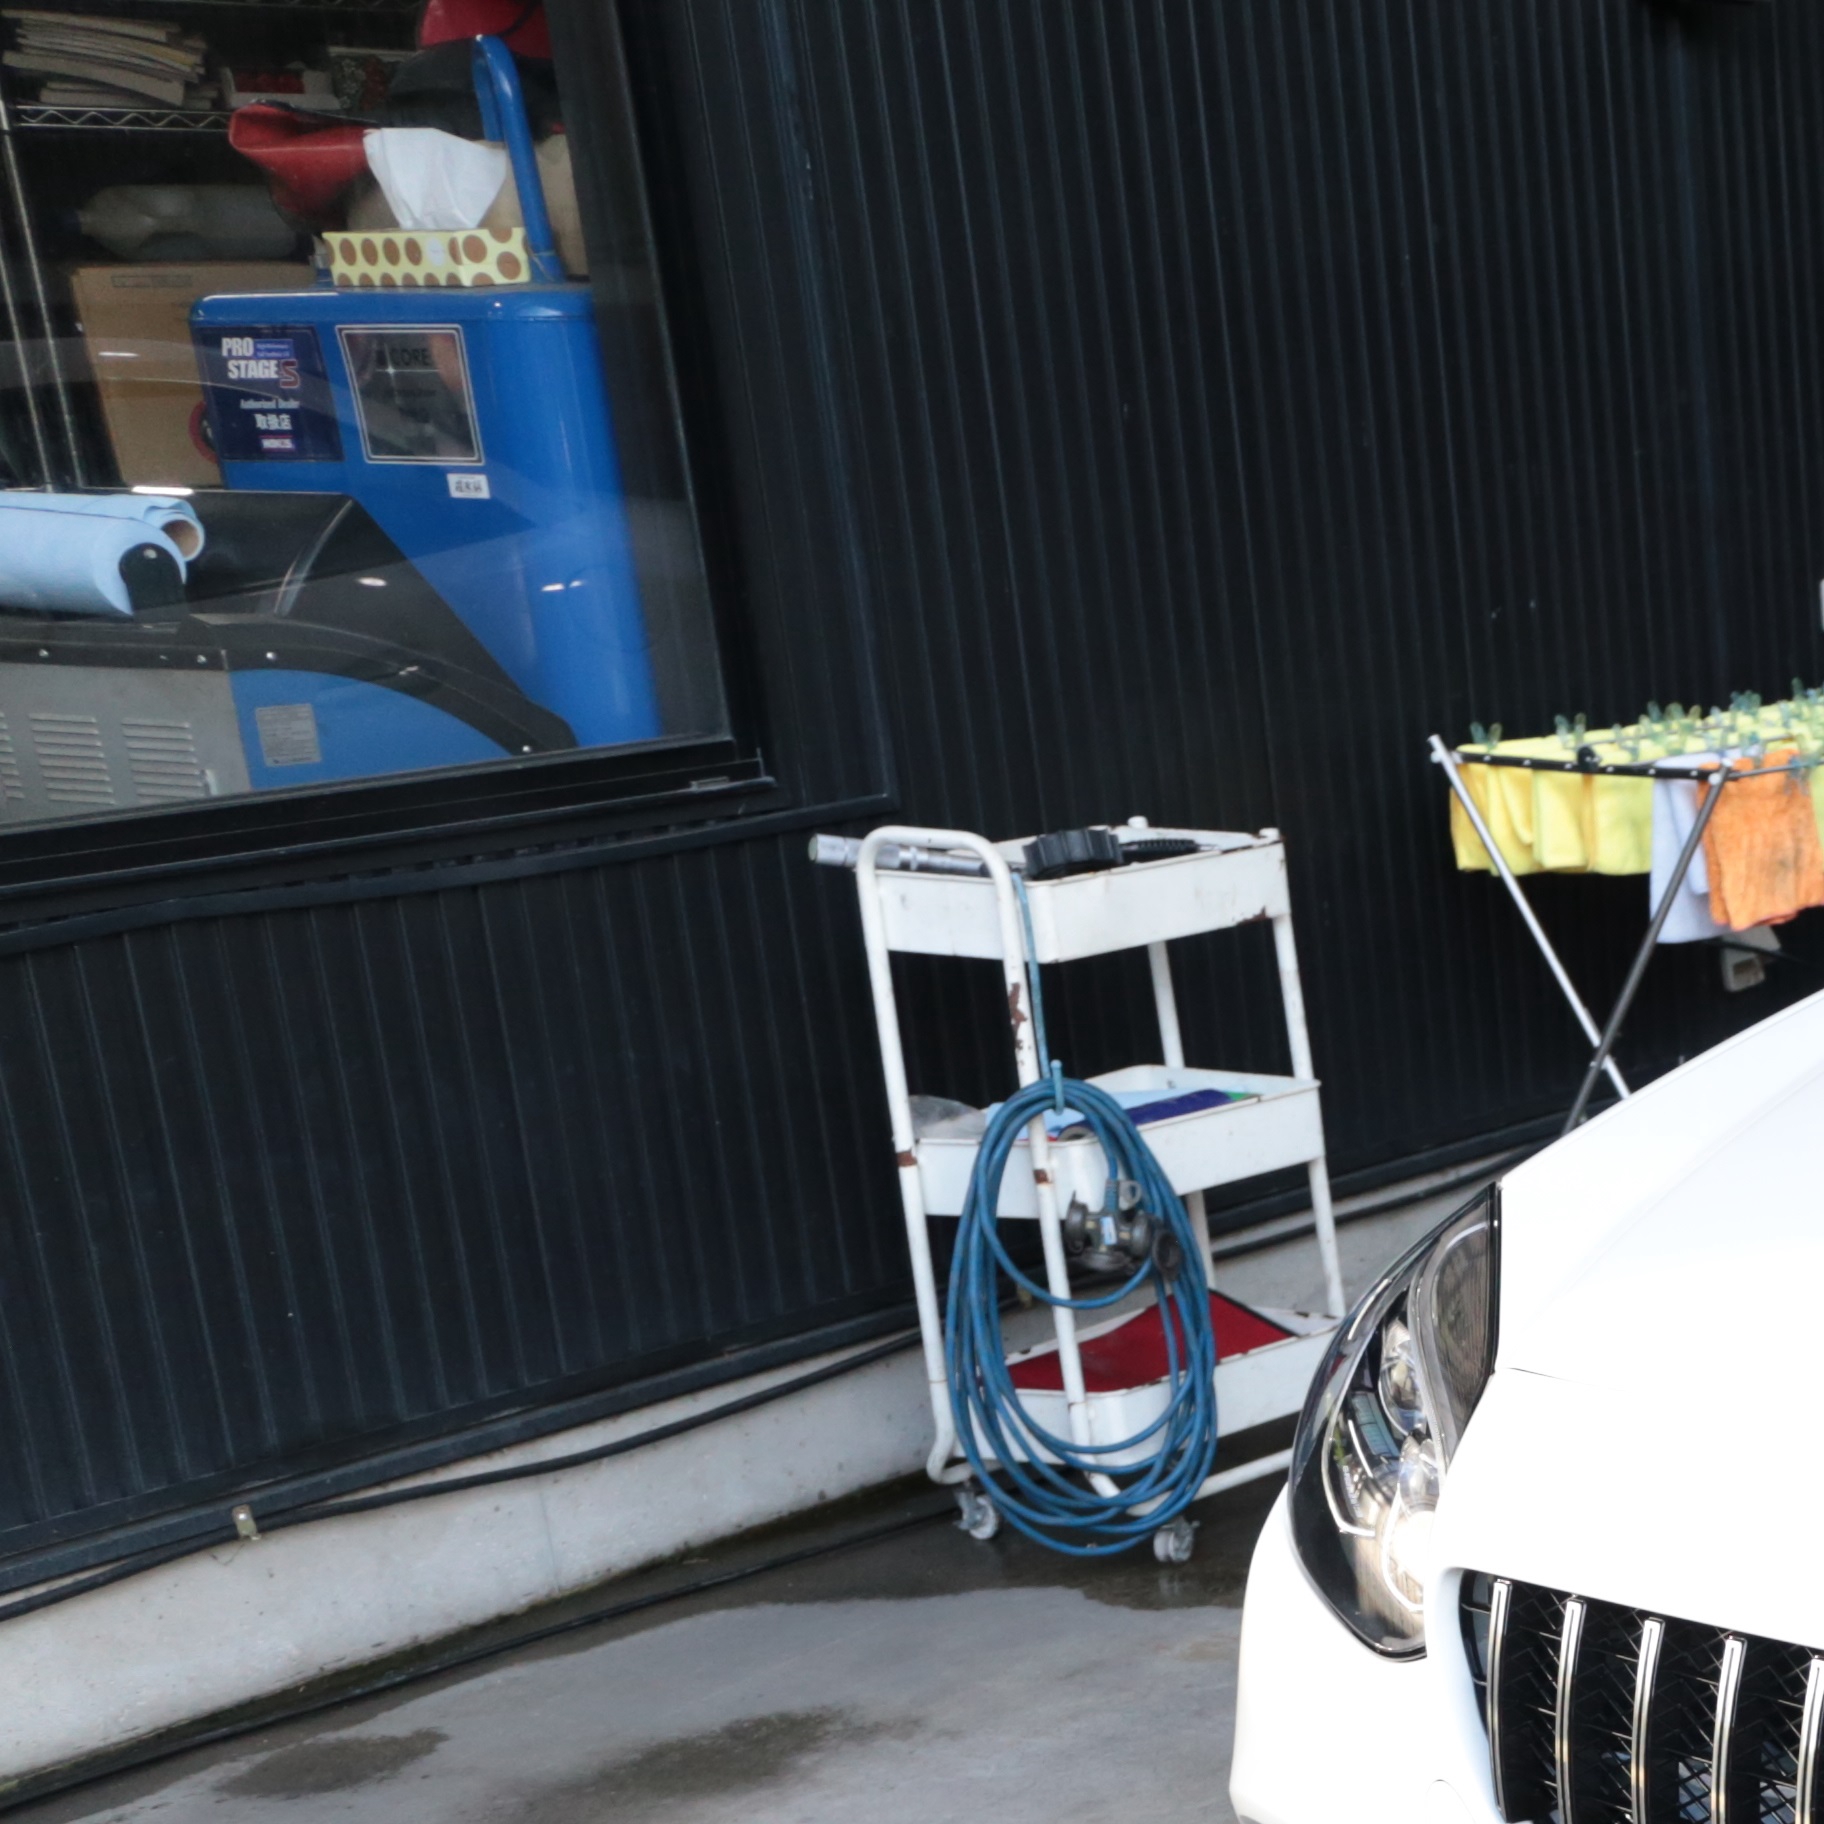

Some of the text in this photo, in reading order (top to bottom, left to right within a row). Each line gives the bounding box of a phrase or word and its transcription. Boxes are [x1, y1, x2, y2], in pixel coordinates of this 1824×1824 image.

[221, 336, 254, 357] PRO
[227, 358, 300, 389] STAGE S
